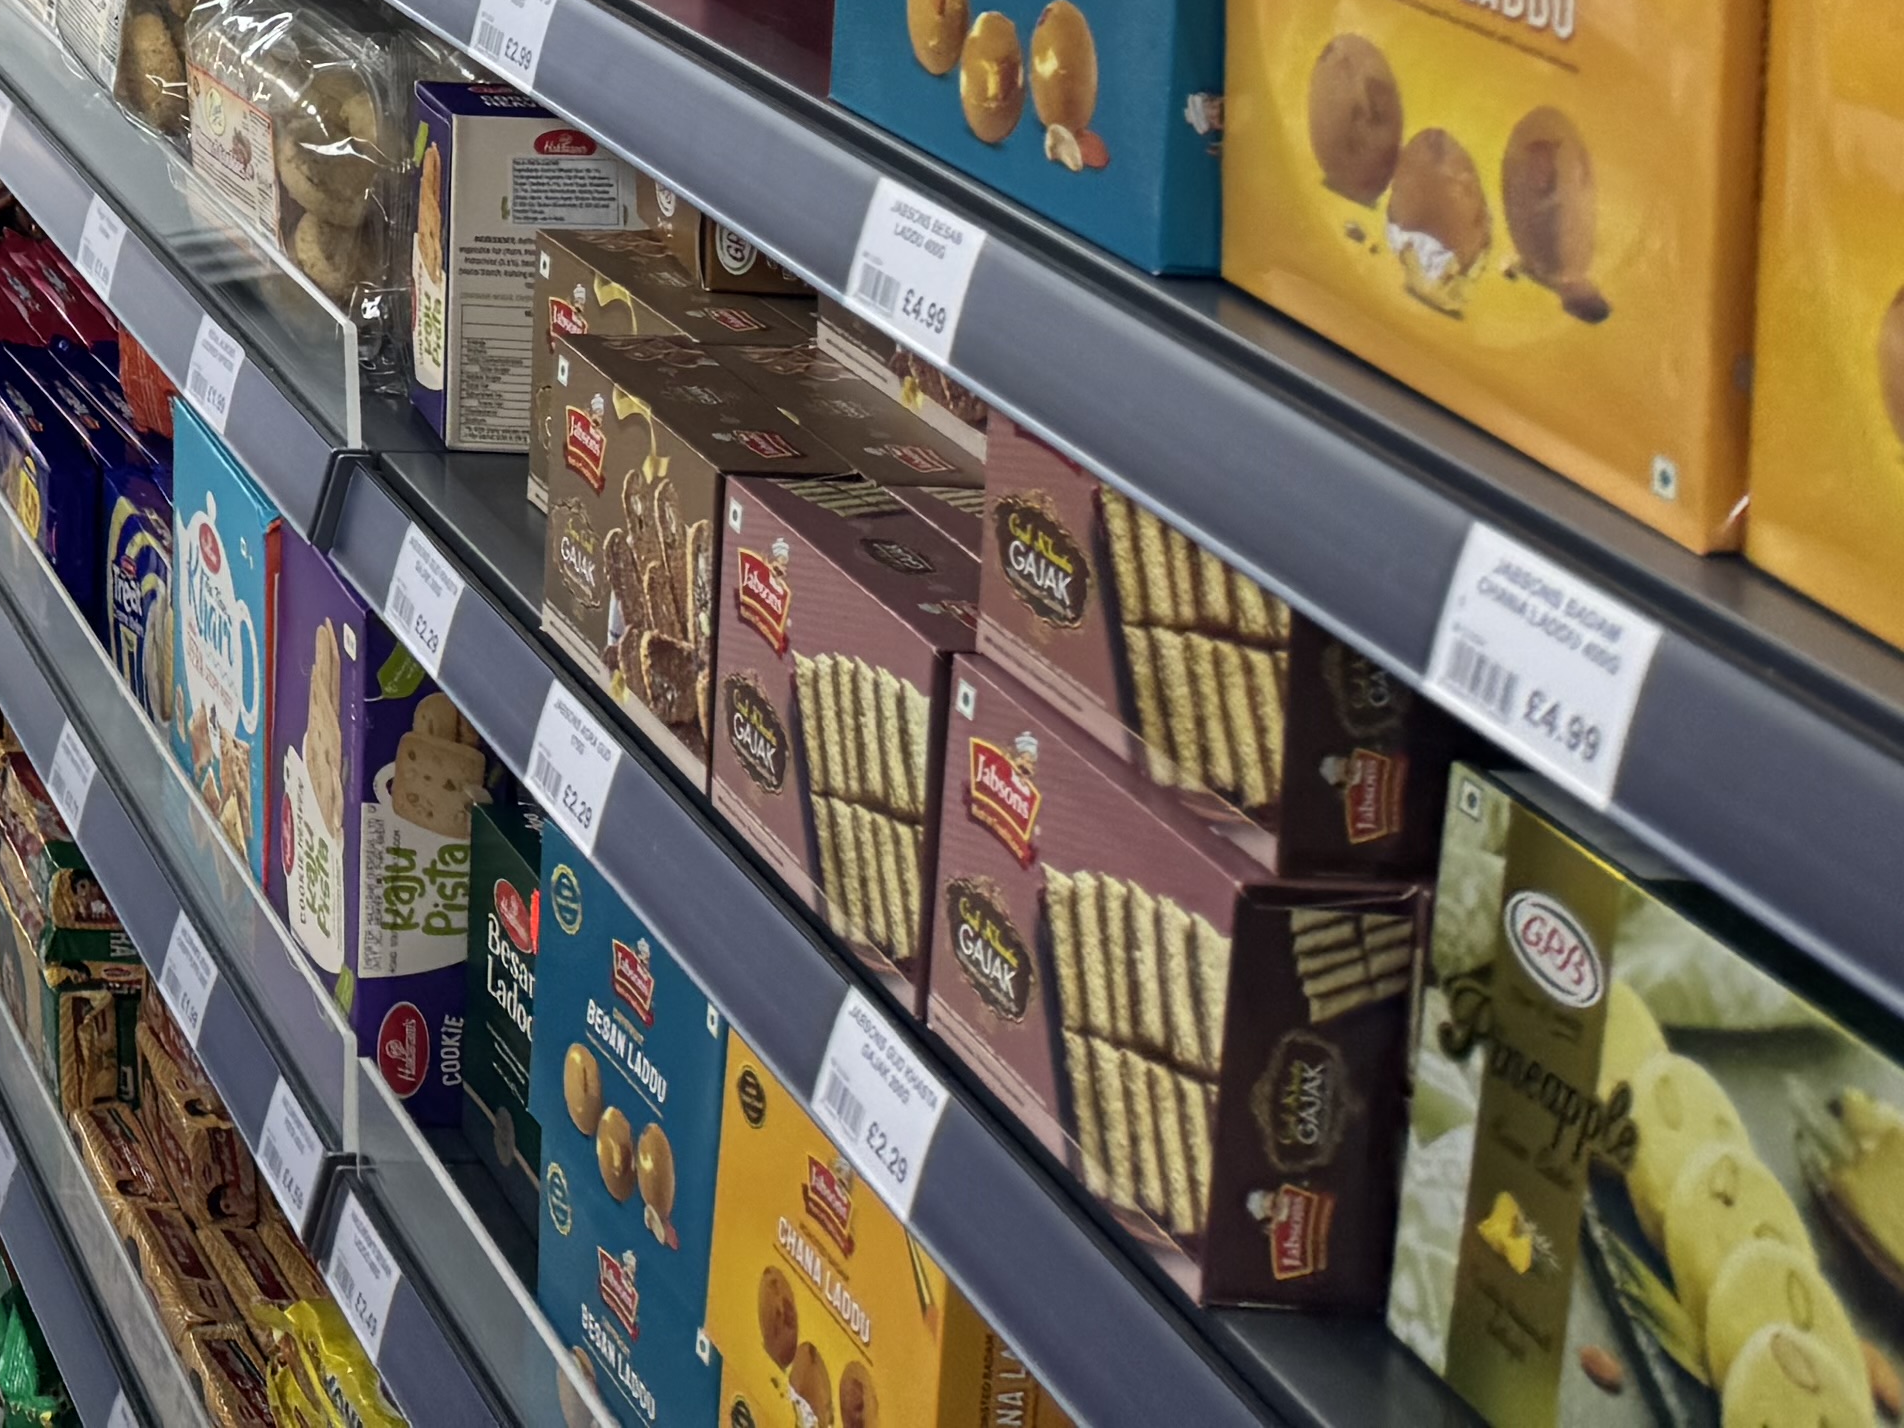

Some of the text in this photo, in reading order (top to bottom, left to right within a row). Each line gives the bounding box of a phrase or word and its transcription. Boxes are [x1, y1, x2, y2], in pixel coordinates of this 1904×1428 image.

[504, 35, 532, 71] £2.99
[901, 287, 947, 337] £4.99
[561, 535, 595, 588] GAJAK
[1008, 540, 1073, 606] GAJAK
[414, 614, 440, 654] £2.29
[731, 714, 777, 774] GAJAK
[1525, 690, 1600, 759] £4.99
[563, 784, 591, 829] £2.29
[976, 756, 1030, 821] Jabsons
[959, 923, 1016, 989] GAJAK
[442, 1015, 464, 1086] COOKIE
[587, 999, 667, 1103] BESAN LADDU
[1296, 1062, 1325, 1142] GAJAK
[867, 1121, 907, 1183] £2.29
[778, 1217, 872, 1343] CHANA LADDU
